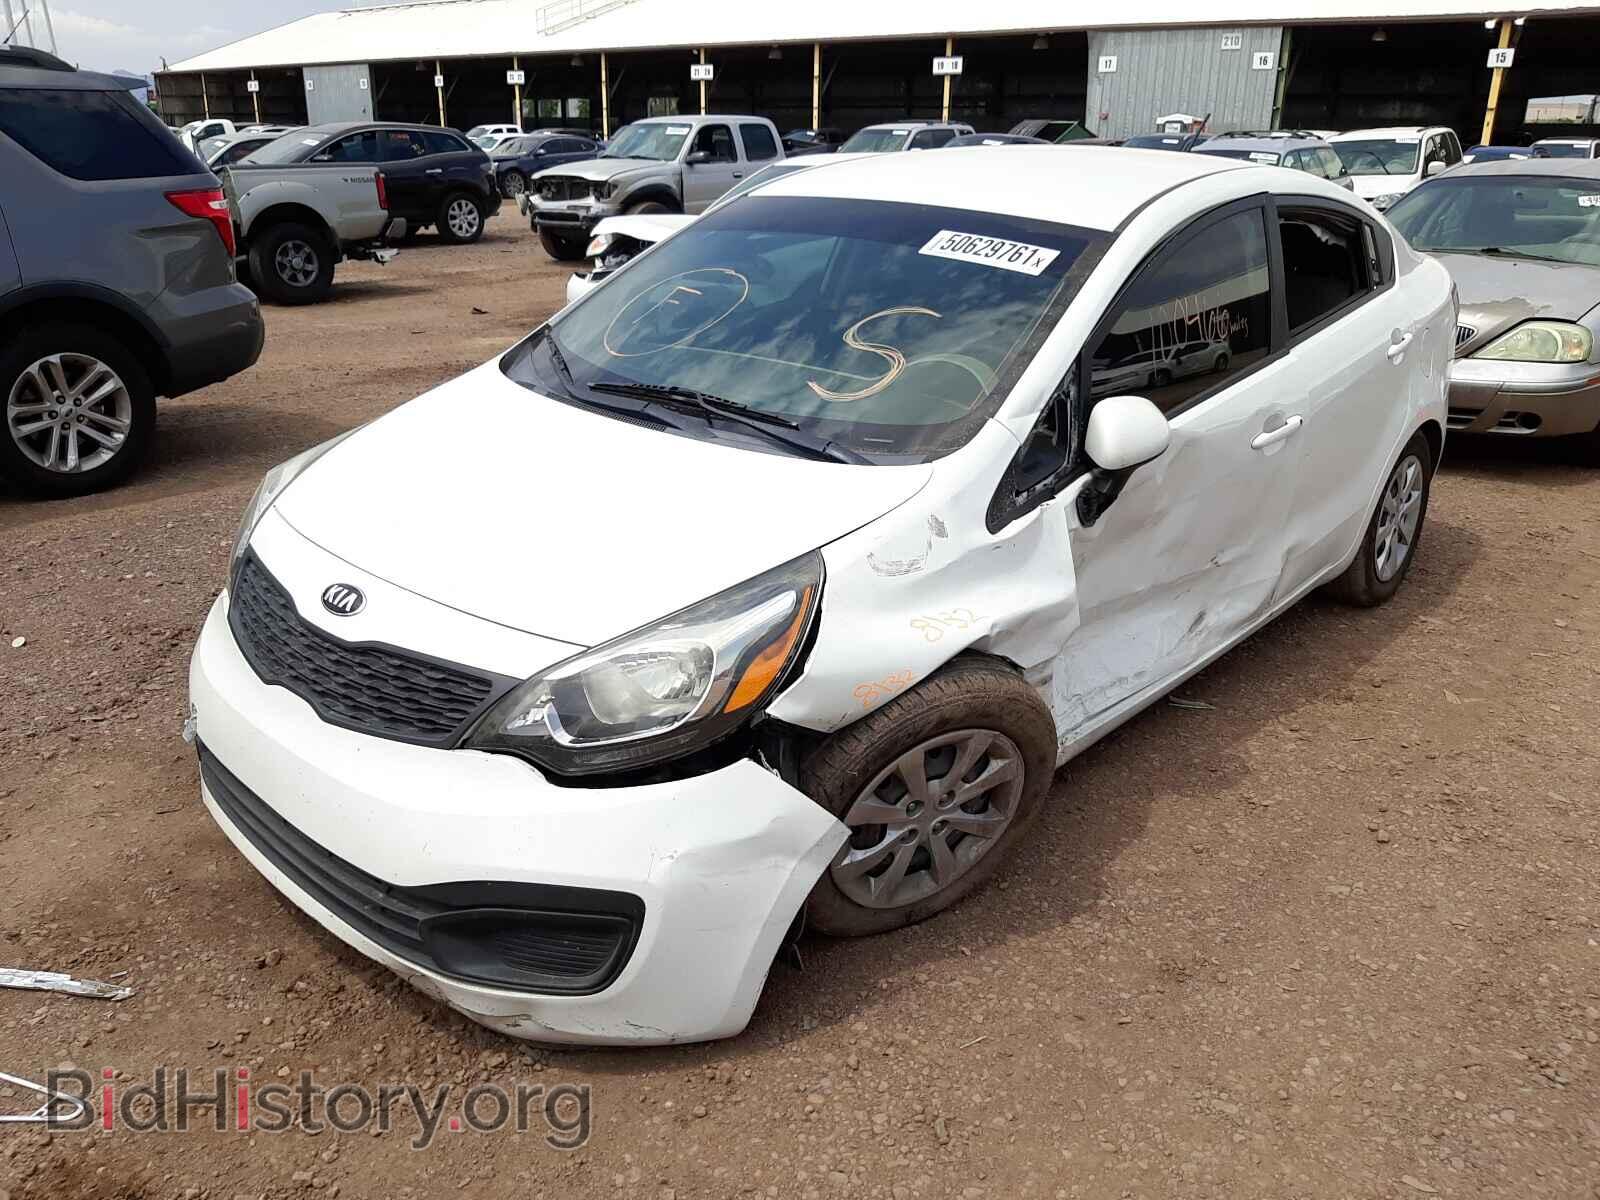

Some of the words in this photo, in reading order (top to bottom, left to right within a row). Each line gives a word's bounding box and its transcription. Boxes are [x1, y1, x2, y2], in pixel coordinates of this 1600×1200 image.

[1223, 36, 1240, 46] 210
[1104, 59, 1112, 69] 17
[1258, 55, 1269, 66] 16
[1495, 51, 1507, 64] 15
[940, 233, 1039, 265] 50629761
[806, 305, 943, 403] S
[323, 584, 358, 612] KIA
